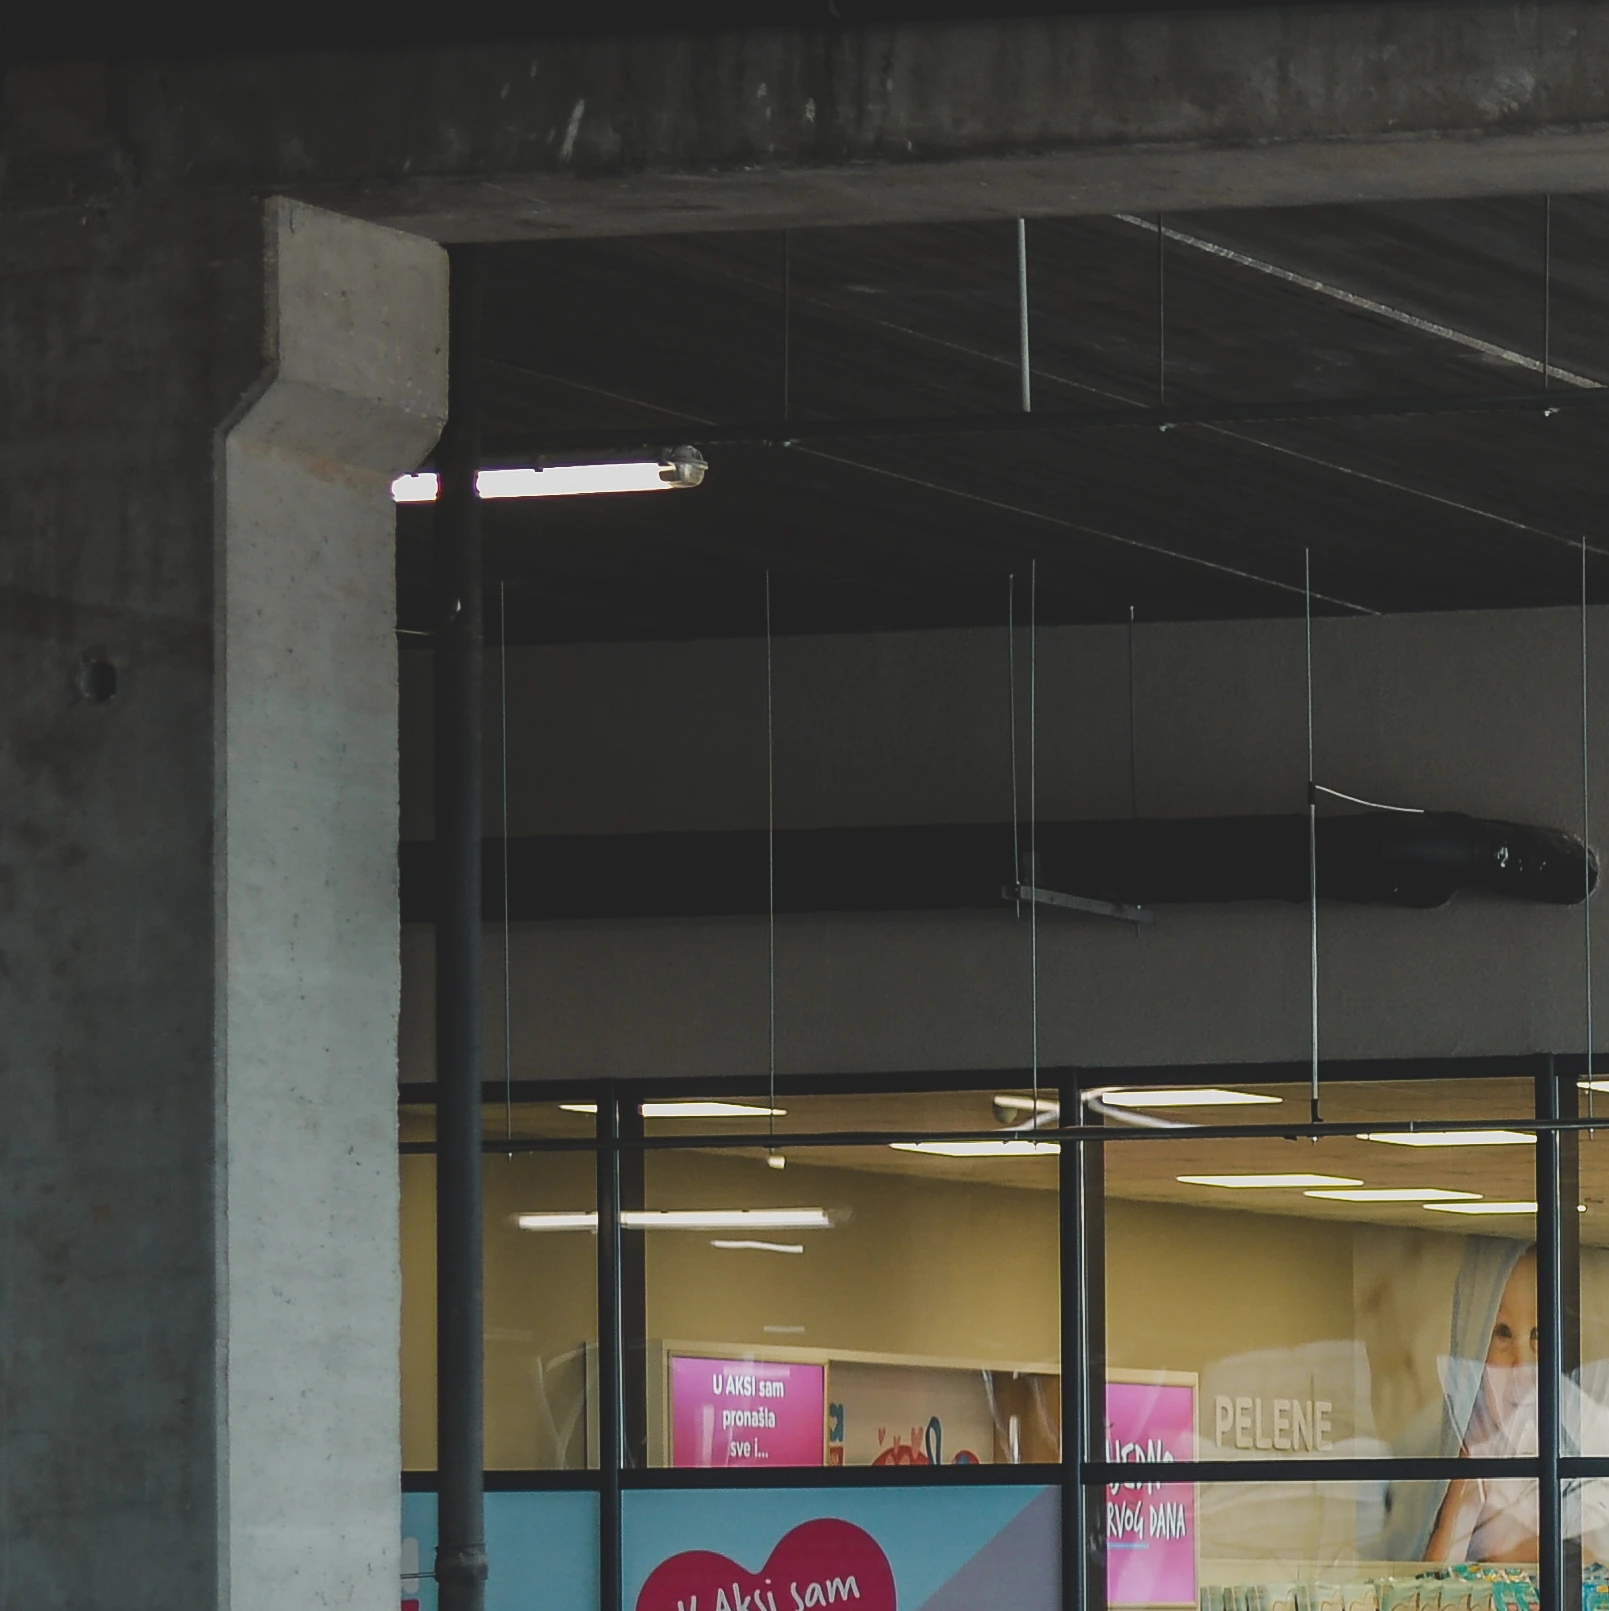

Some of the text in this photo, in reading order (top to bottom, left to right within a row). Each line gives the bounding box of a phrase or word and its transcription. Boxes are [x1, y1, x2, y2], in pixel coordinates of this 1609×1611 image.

[712, 1374, 785, 1398] U AKSI sam
[722, 1406, 776, 1430] pronašla
[1214, 1395, 1333, 1452] PELENE
[730, 1440, 751, 1458] sve
[1107, 1501, 1187, 1541] RVOG DANA
